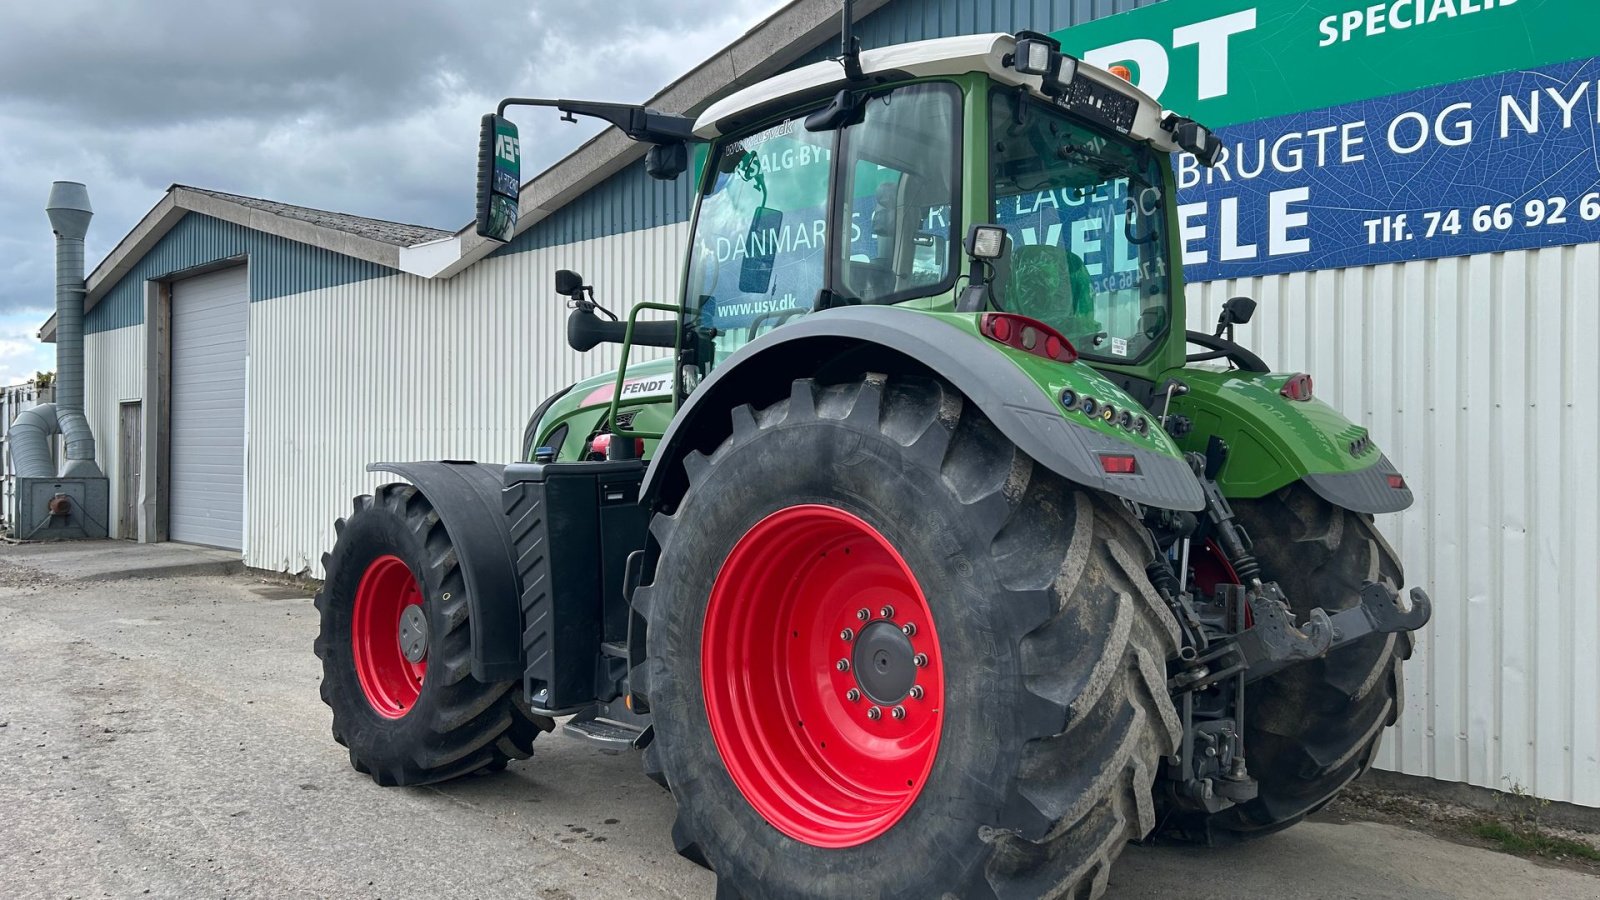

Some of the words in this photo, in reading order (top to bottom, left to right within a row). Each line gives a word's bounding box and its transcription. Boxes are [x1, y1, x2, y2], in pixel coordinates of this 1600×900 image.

[1319, 0, 1518, 47] SPECIA
[1178, 121, 1366, 189] BRUGTE
[1388, 102, 1472, 155] OG
[1500, 81, 1600, 138] NY
[1364, 214, 1413, 245] Tlf.
[1424, 209, 1462, 238] 74
[1472, 203, 1513, 232] 66
[1525, 197, 1567, 227] 92
[718, 294, 797, 317] www.usv.dk
[623, 380, 666, 394] FENDT
